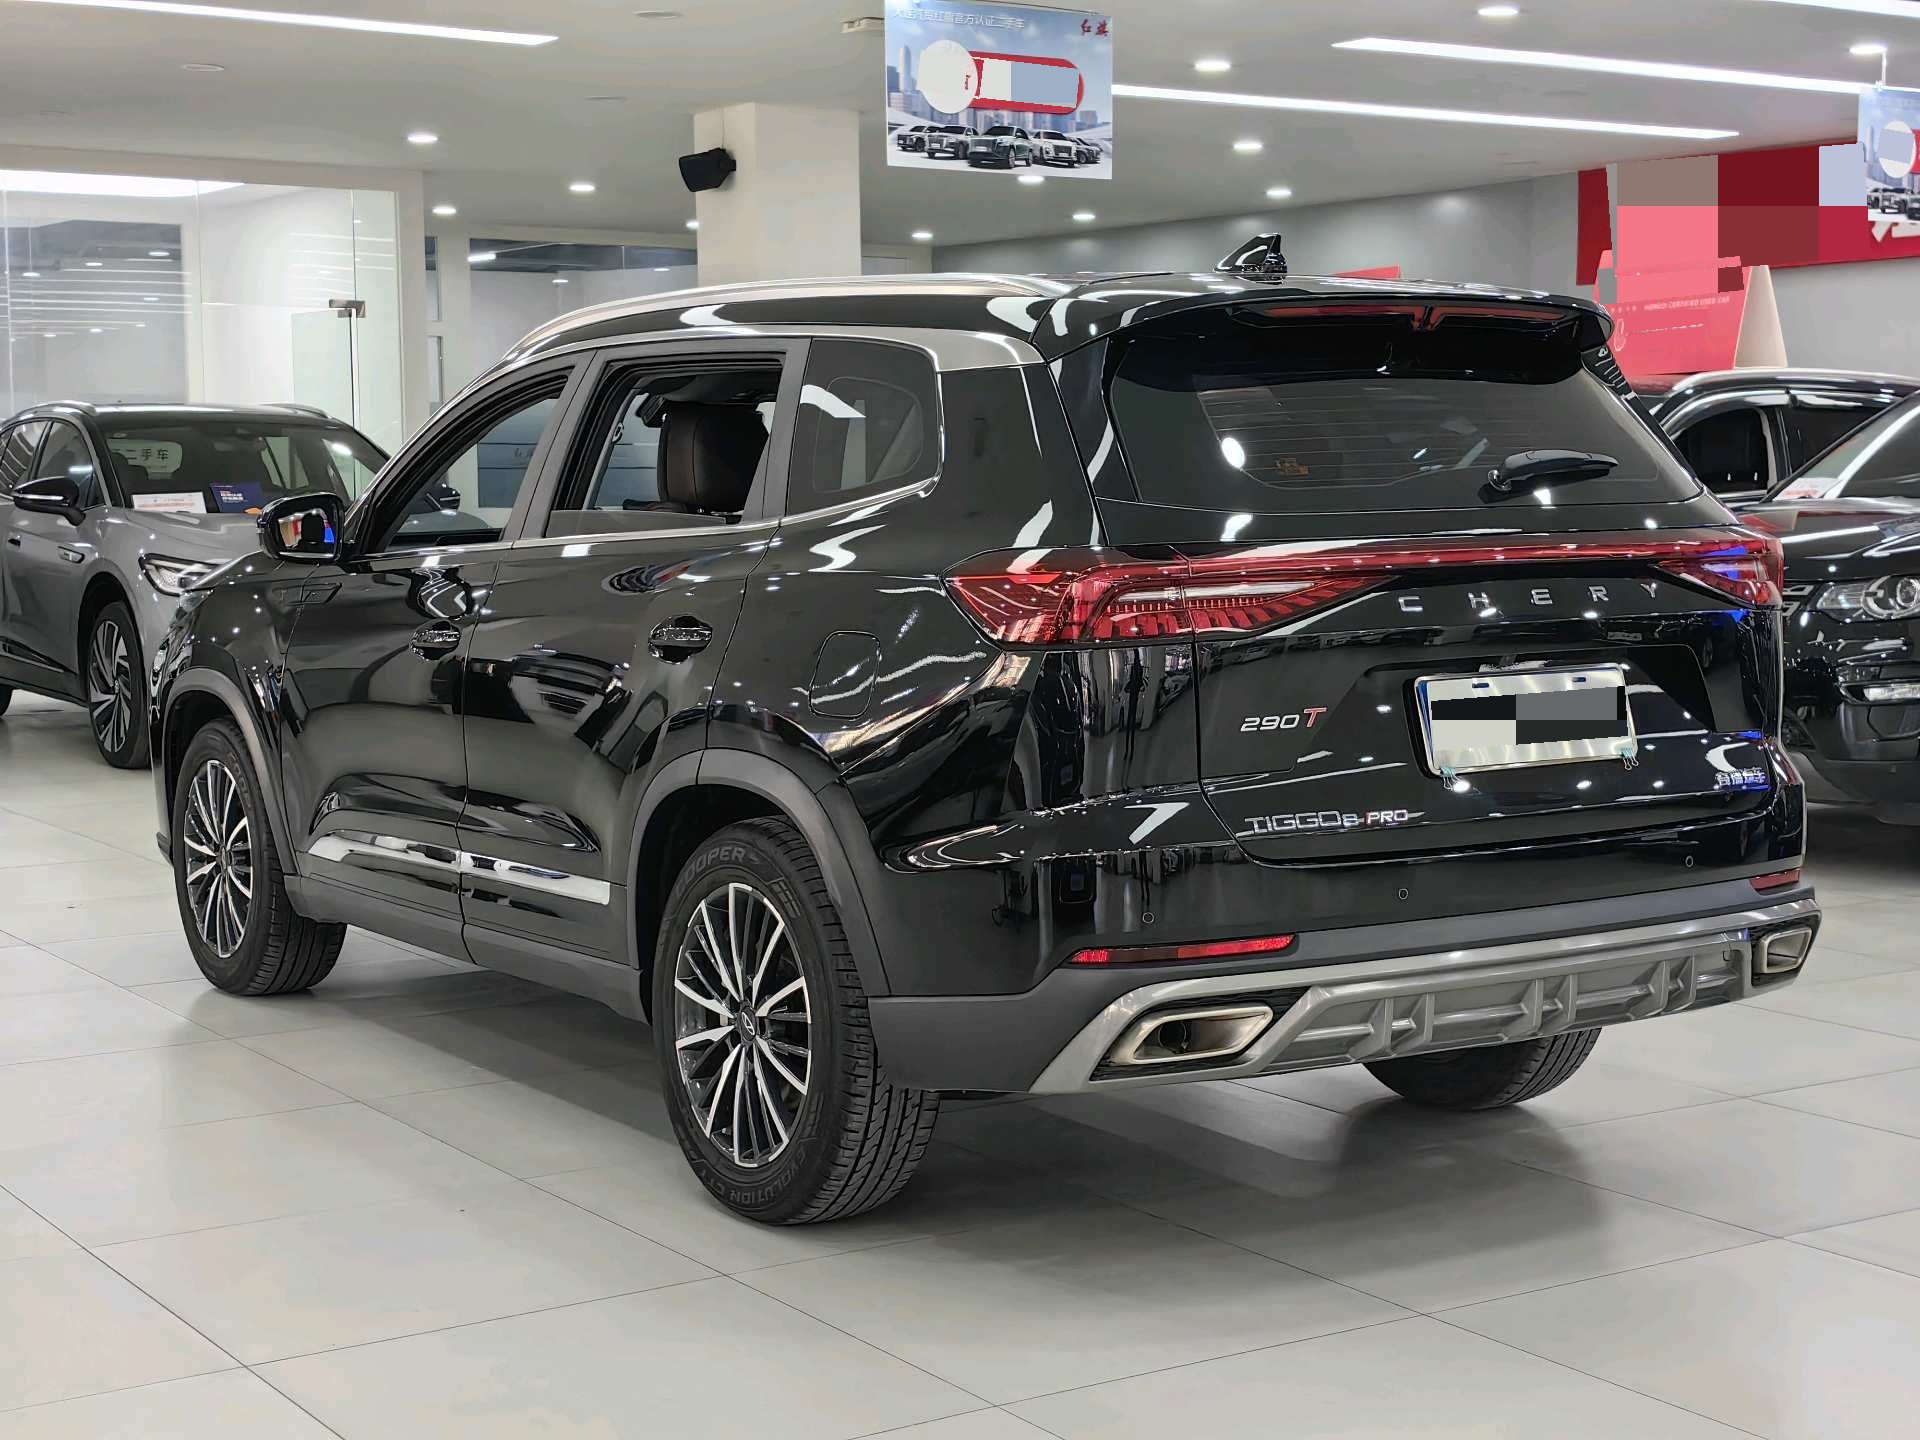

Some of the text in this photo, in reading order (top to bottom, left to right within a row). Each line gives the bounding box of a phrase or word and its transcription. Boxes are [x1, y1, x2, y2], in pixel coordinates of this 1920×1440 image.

[112, 448, 169, 464] 二手车
[1398, 583, 1657, 613] CHERY
[1366, 809, 1409, 826] PRO
